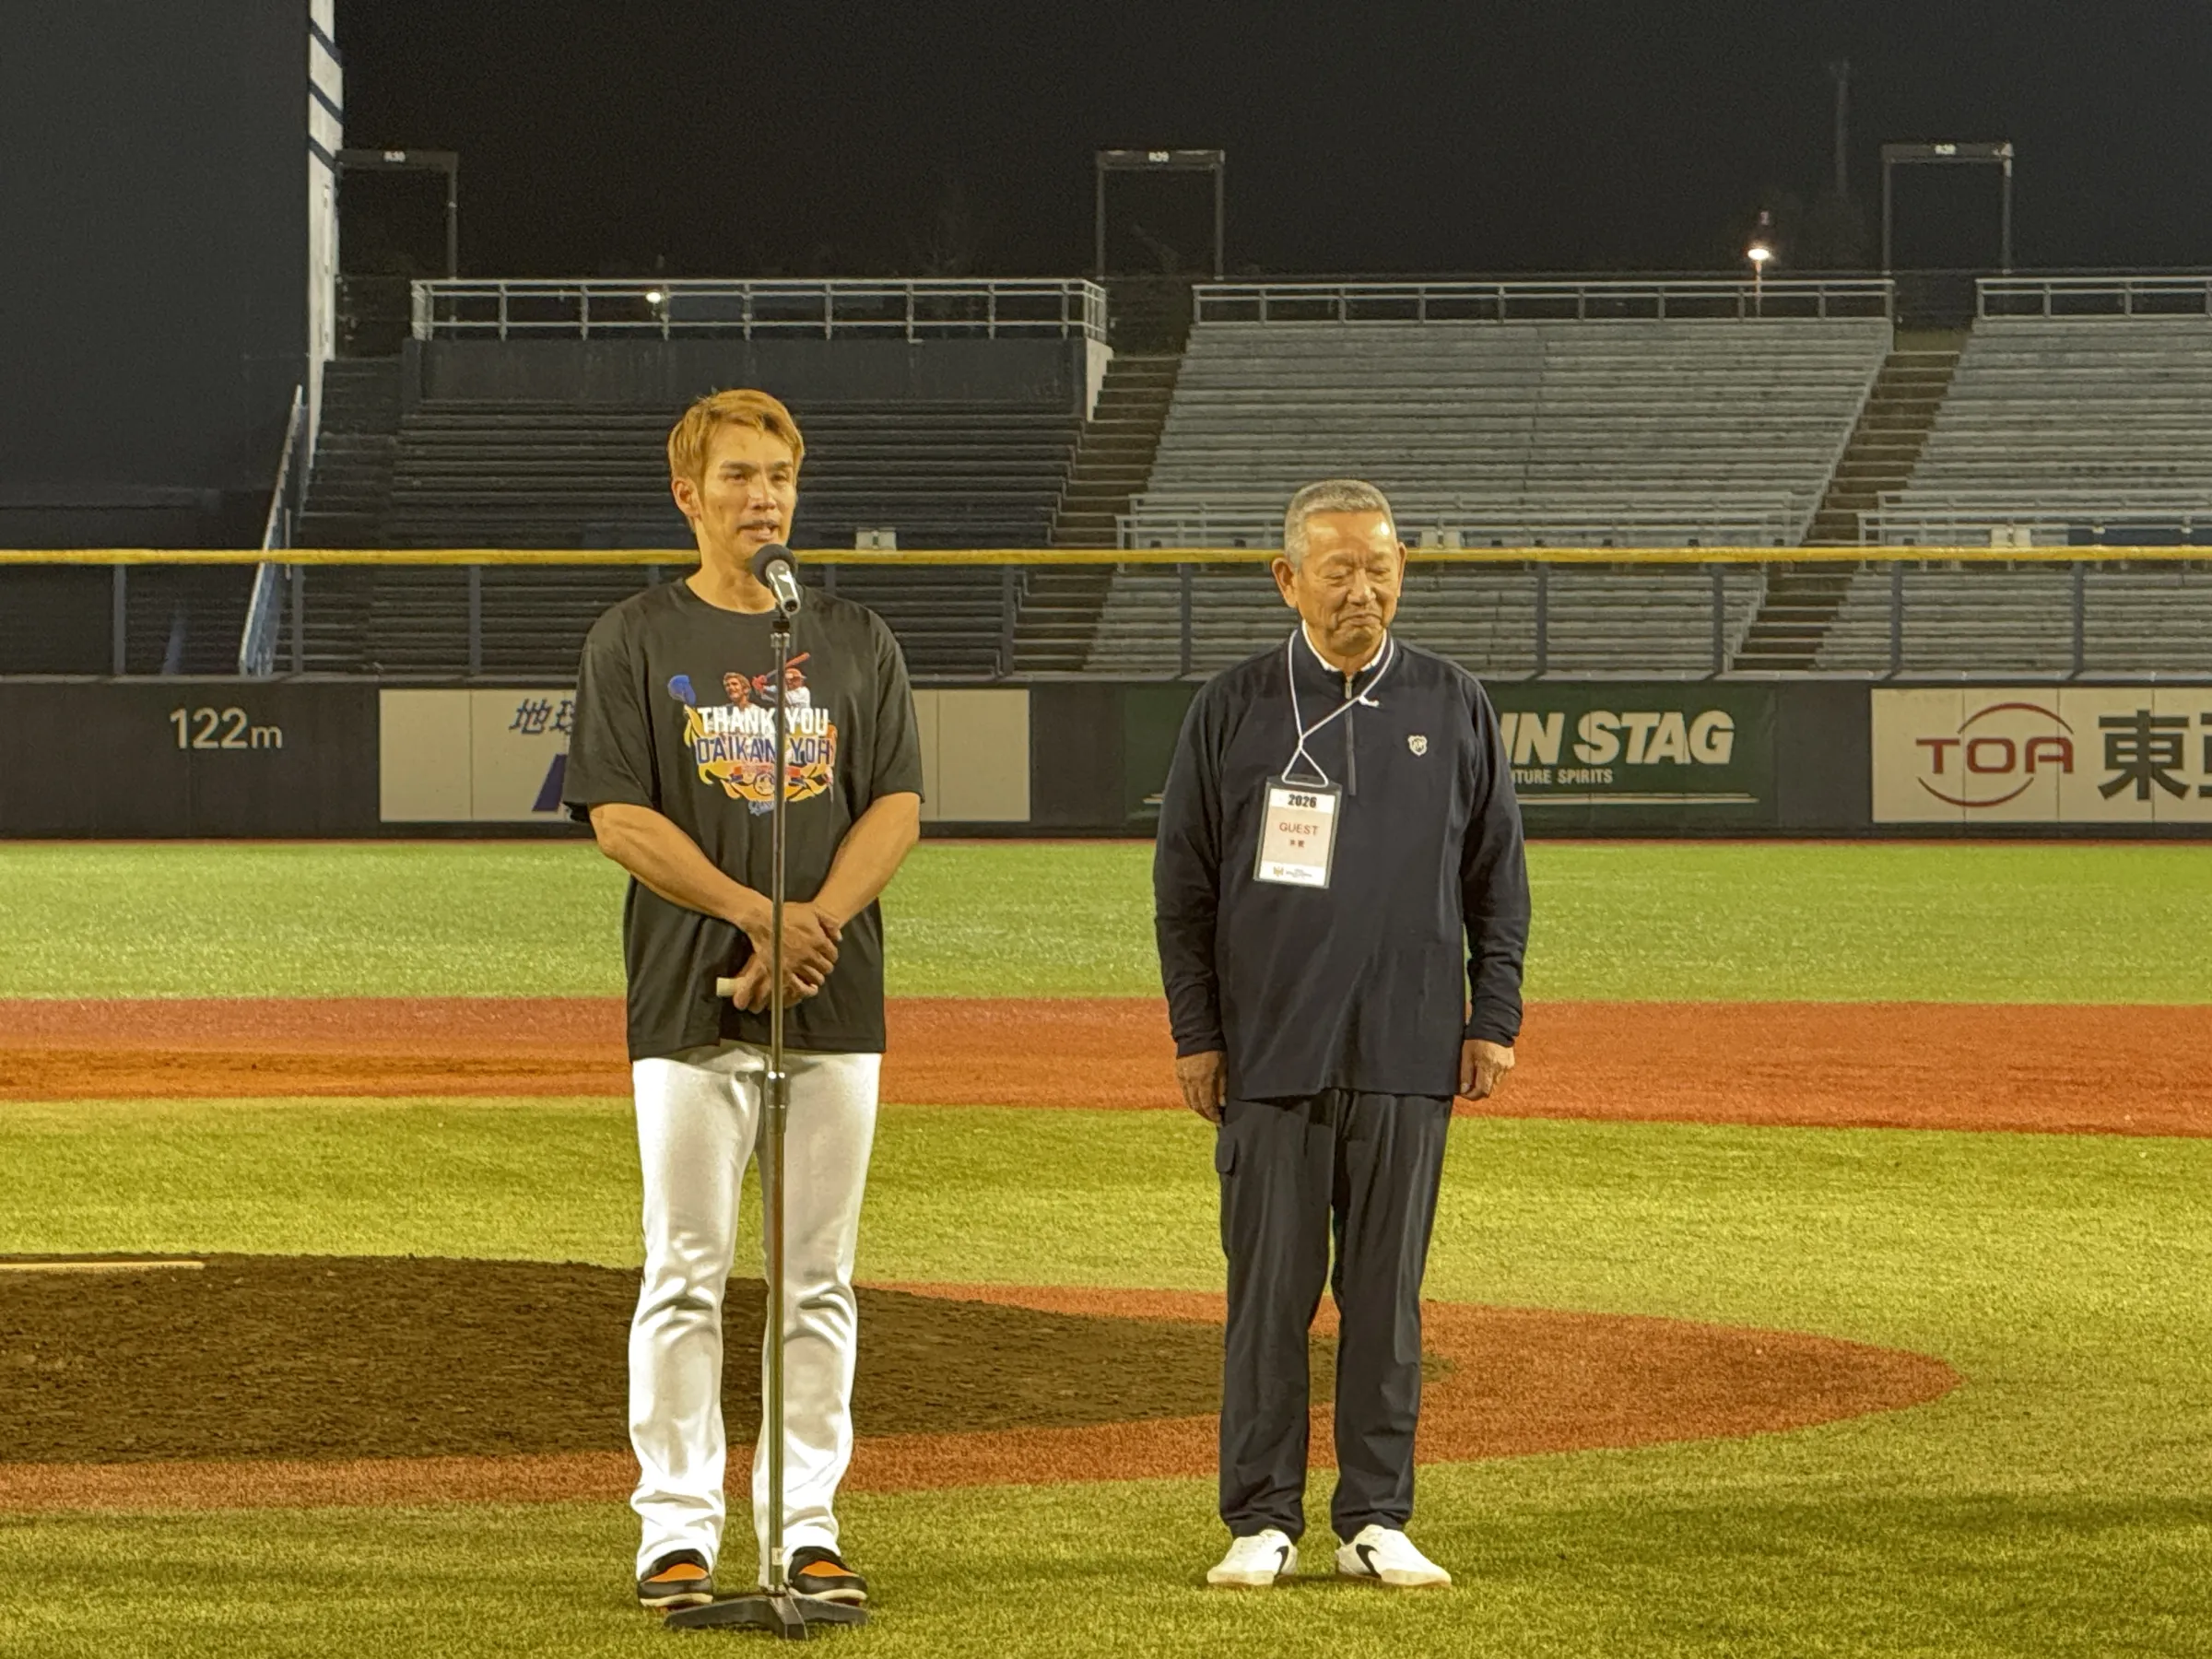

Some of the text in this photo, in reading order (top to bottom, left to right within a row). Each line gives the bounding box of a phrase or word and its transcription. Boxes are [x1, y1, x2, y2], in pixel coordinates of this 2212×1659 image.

[170, 706, 283, 749] 122m
[697, 706, 829, 735] THANK YOU
[1573, 710, 1735, 765] STAG
[1915, 737, 2074, 774] TOA
[2098, 709, 2212, 801] 東
[1558, 768, 1613, 784] SPIRITS
[1288, 794, 1317, 808] 2026
[1279, 822, 1319, 836] GUEST
